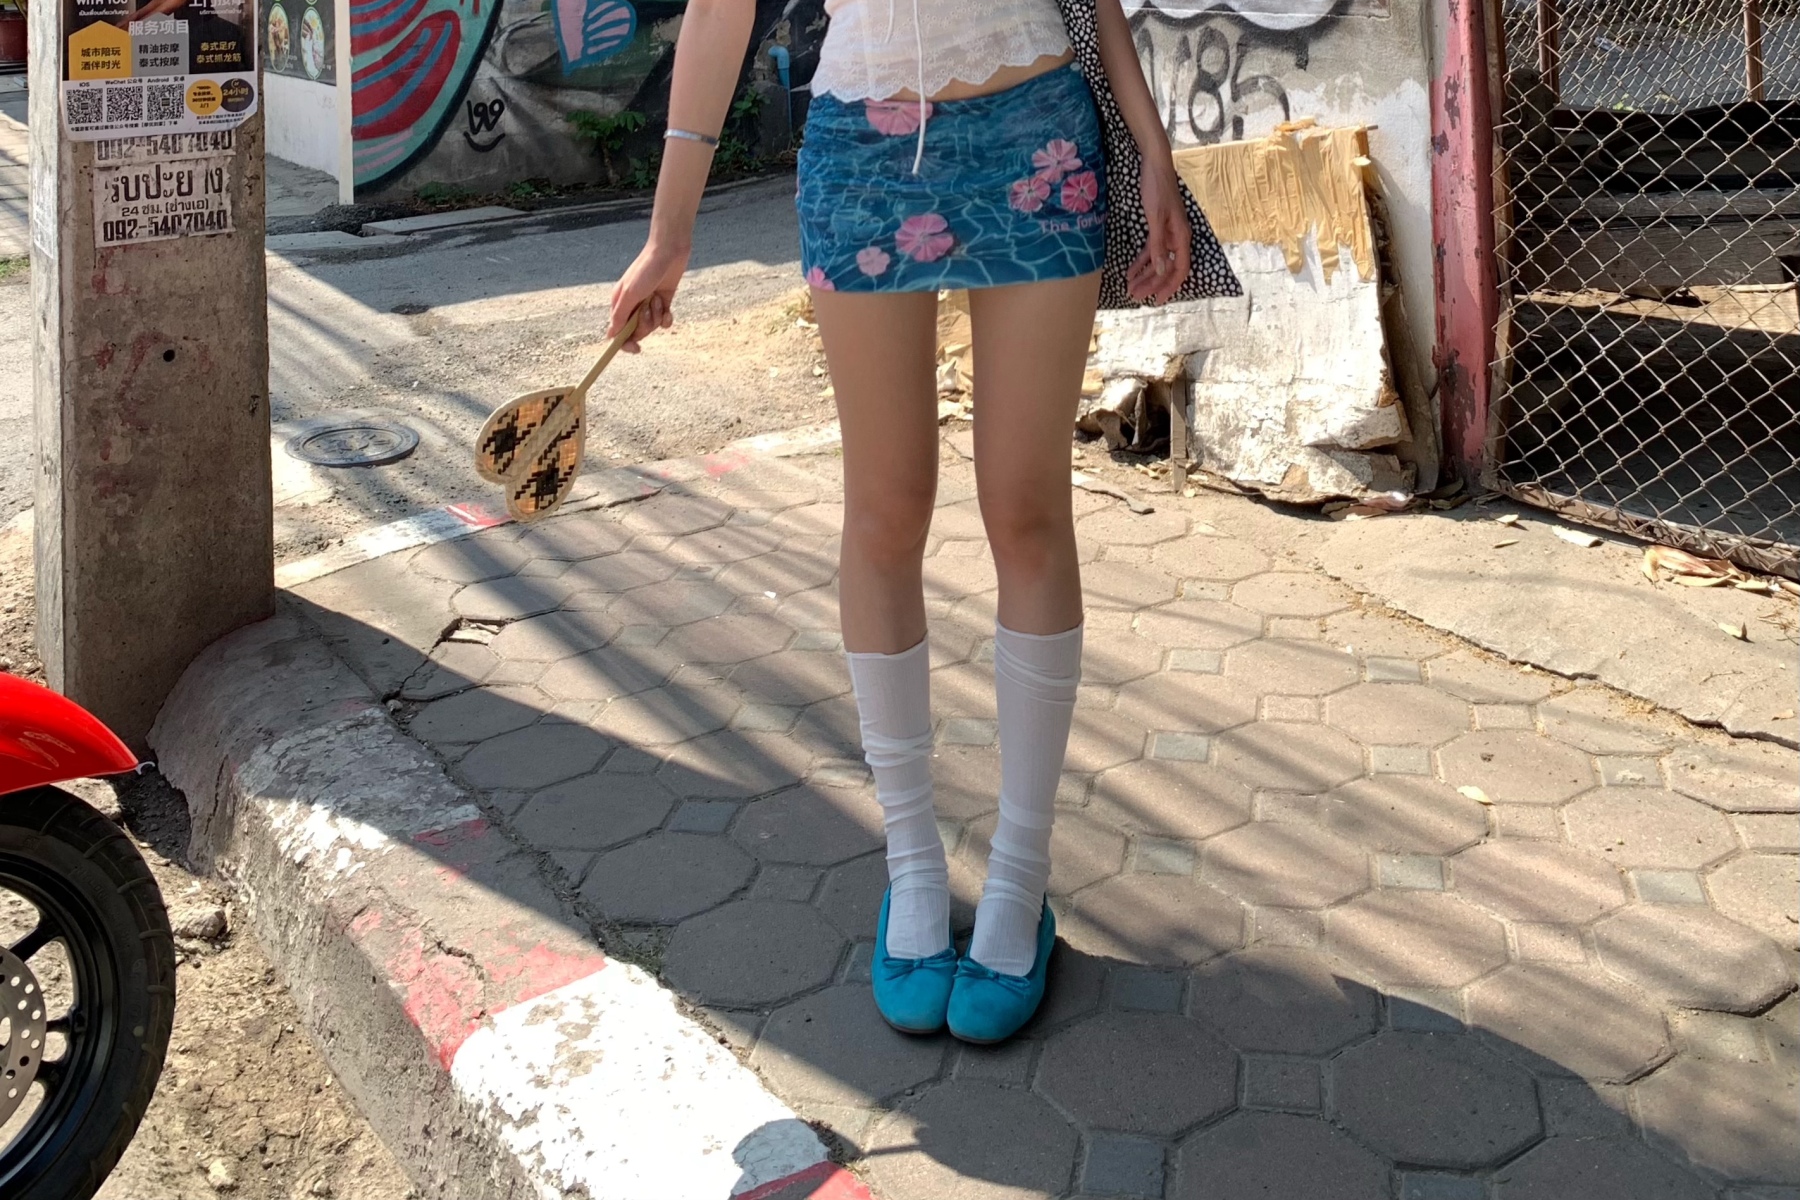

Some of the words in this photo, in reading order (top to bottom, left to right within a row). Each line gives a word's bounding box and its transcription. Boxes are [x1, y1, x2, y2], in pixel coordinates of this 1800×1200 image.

[128, 19, 189, 36] 服务项目
[81, 47, 121, 57] 城市陪玩
[139, 43, 180, 54] 精油按摩
[201, 41, 237, 51] 泰式足疗
[81, 60, 121, 71] 酒伴时光
[139, 56, 180, 68] 泰式按摩
[223, 87, 249, 96] 24小时
[97, 130, 232, 161] 092-5407040
[121, 206, 139, 217] 24
[141, 204, 162, 215] ชม.
[103, 209, 227, 242] 092-5407040
[1038, 219, 1071, 234] The
